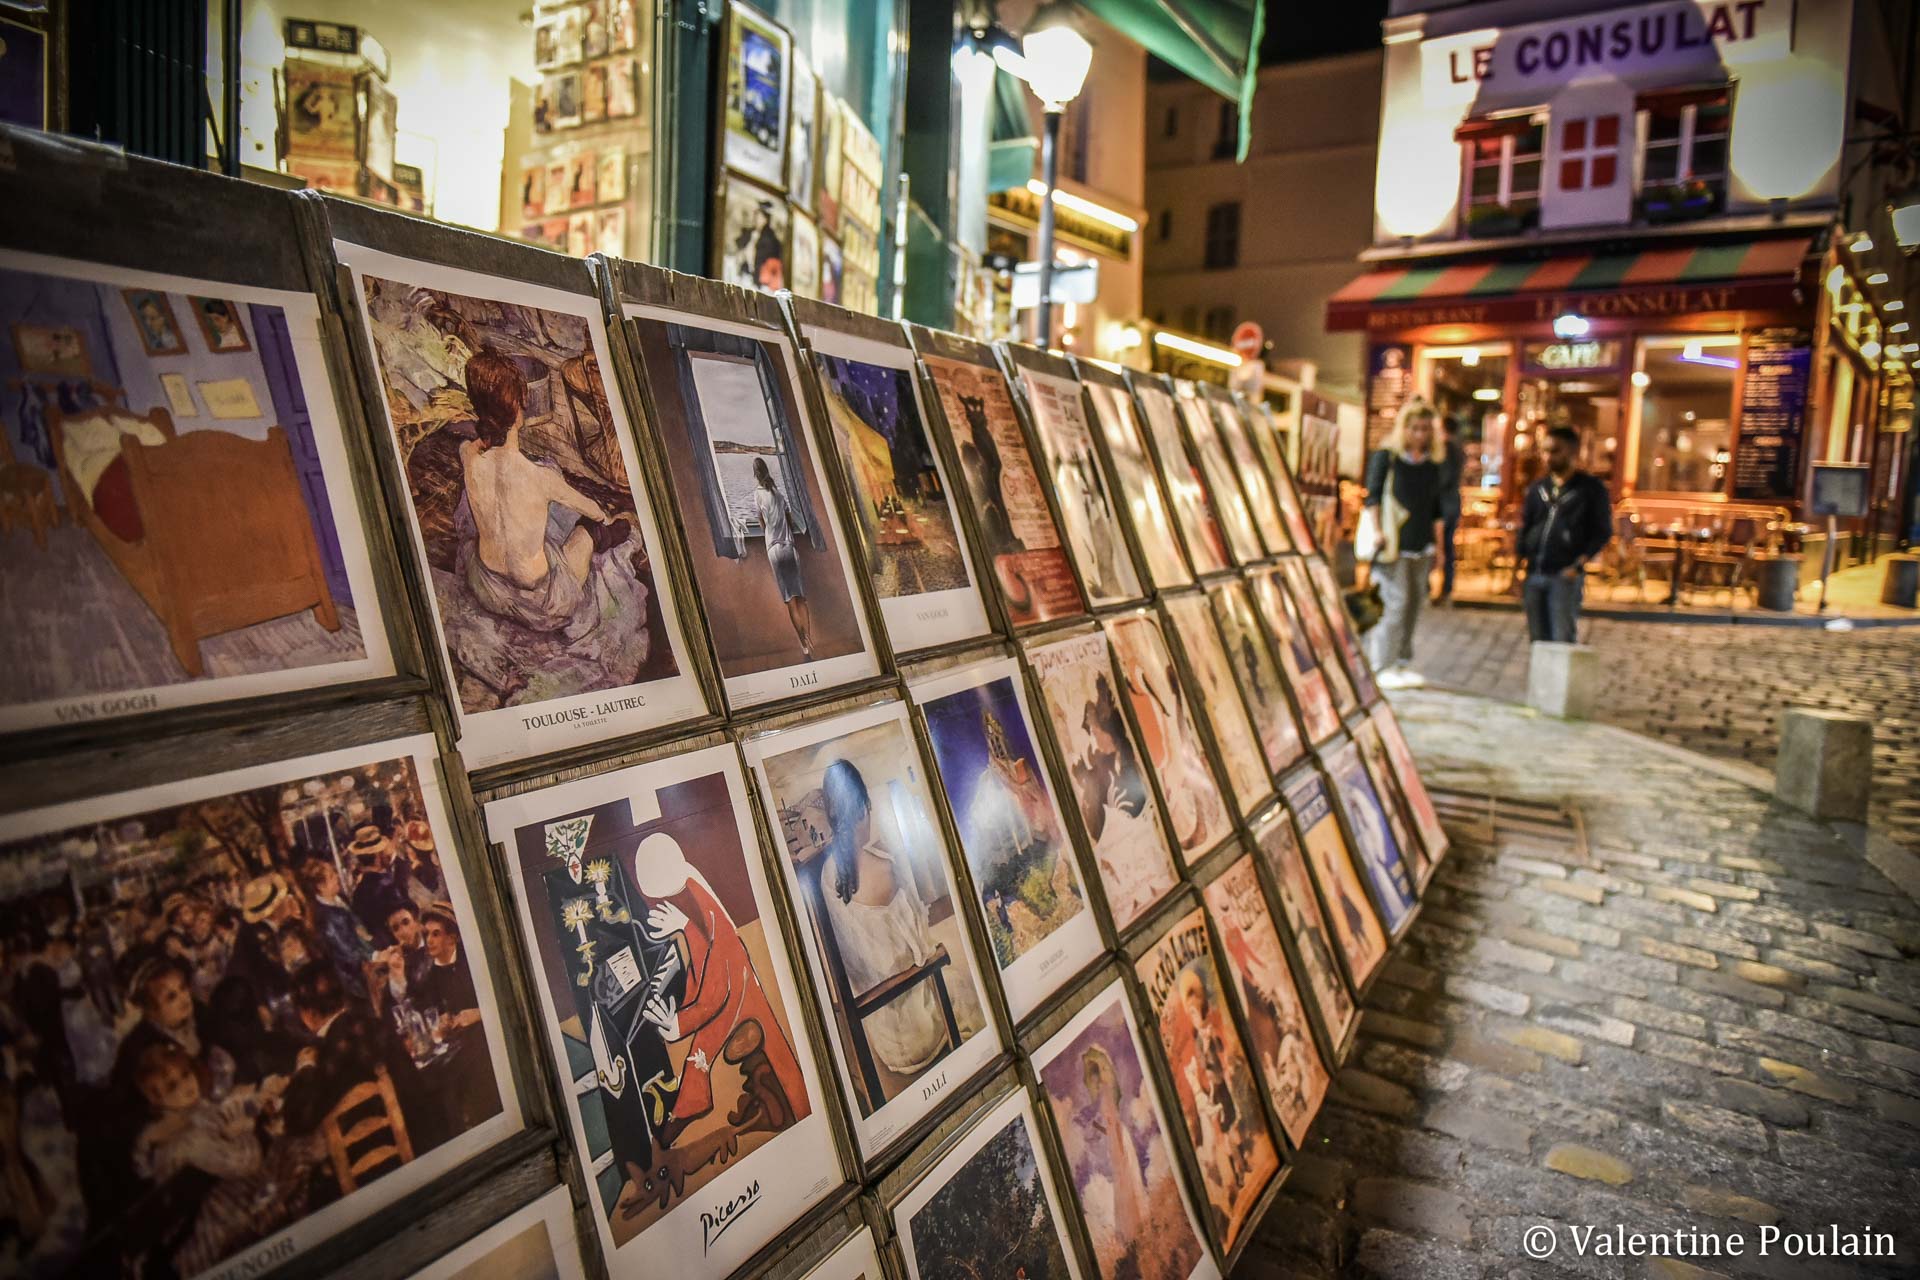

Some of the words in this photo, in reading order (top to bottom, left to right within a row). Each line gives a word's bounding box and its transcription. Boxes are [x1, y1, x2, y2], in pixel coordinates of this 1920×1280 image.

[1450, 45, 1496, 84] LE
[1515, 0, 1764, 75] CONSULAT
[1580, 287, 1734, 315] CONSULAT
[54, 701, 98, 722] VAN
[101, 693, 158, 715] GOGH
[522, 707, 588, 731] TOULOUSE
[596, 695, 647, 716] LAUTREC
[700, 1179, 762, 1258] Picasso
